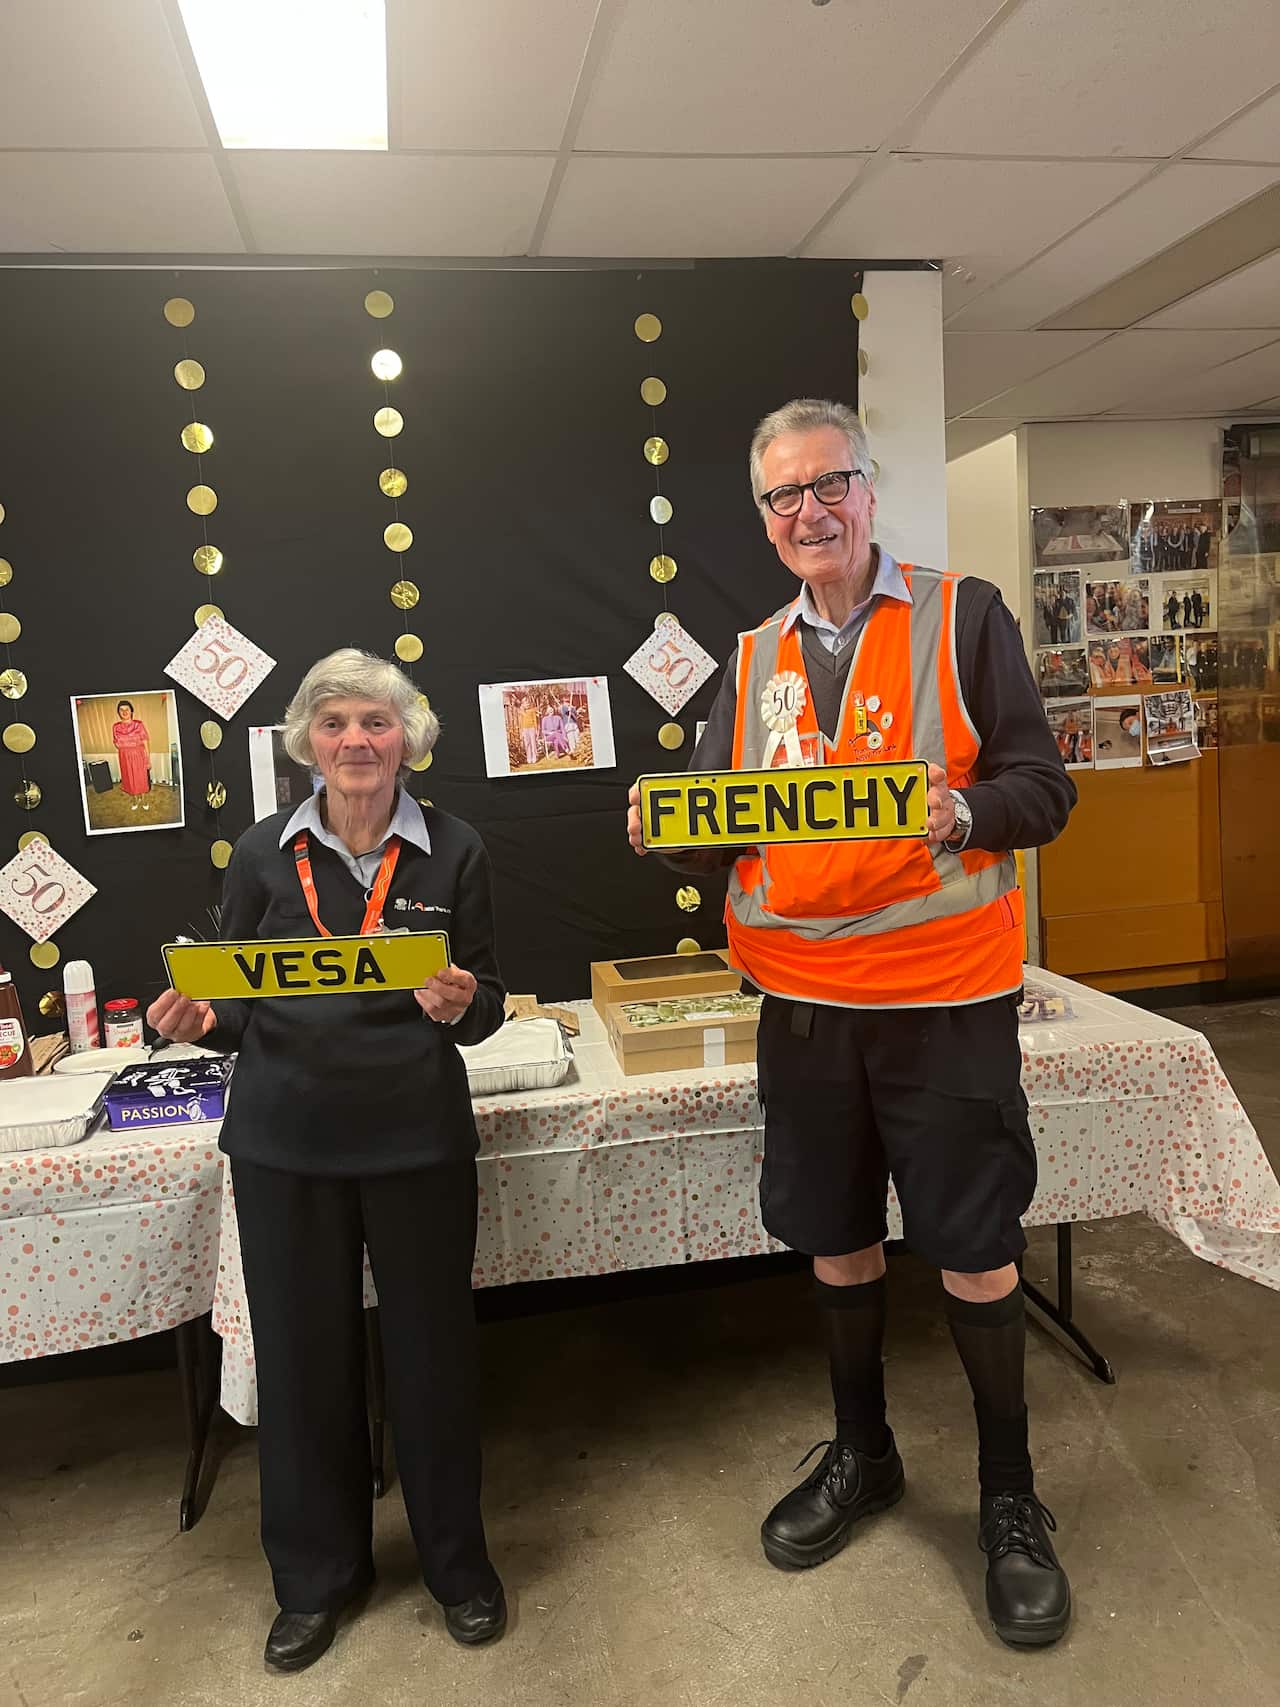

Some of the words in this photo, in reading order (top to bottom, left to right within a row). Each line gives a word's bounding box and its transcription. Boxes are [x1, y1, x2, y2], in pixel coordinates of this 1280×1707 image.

[194, 639, 248, 690] 50
[649, 641, 694, 688] 50
[774, 686, 795, 715] 50
[649, 775, 918, 837] FRENCHY
[12, 864, 65, 914] 50
[233, 947, 386, 990] VESA
[121, 1105, 190, 1121] PASSION
